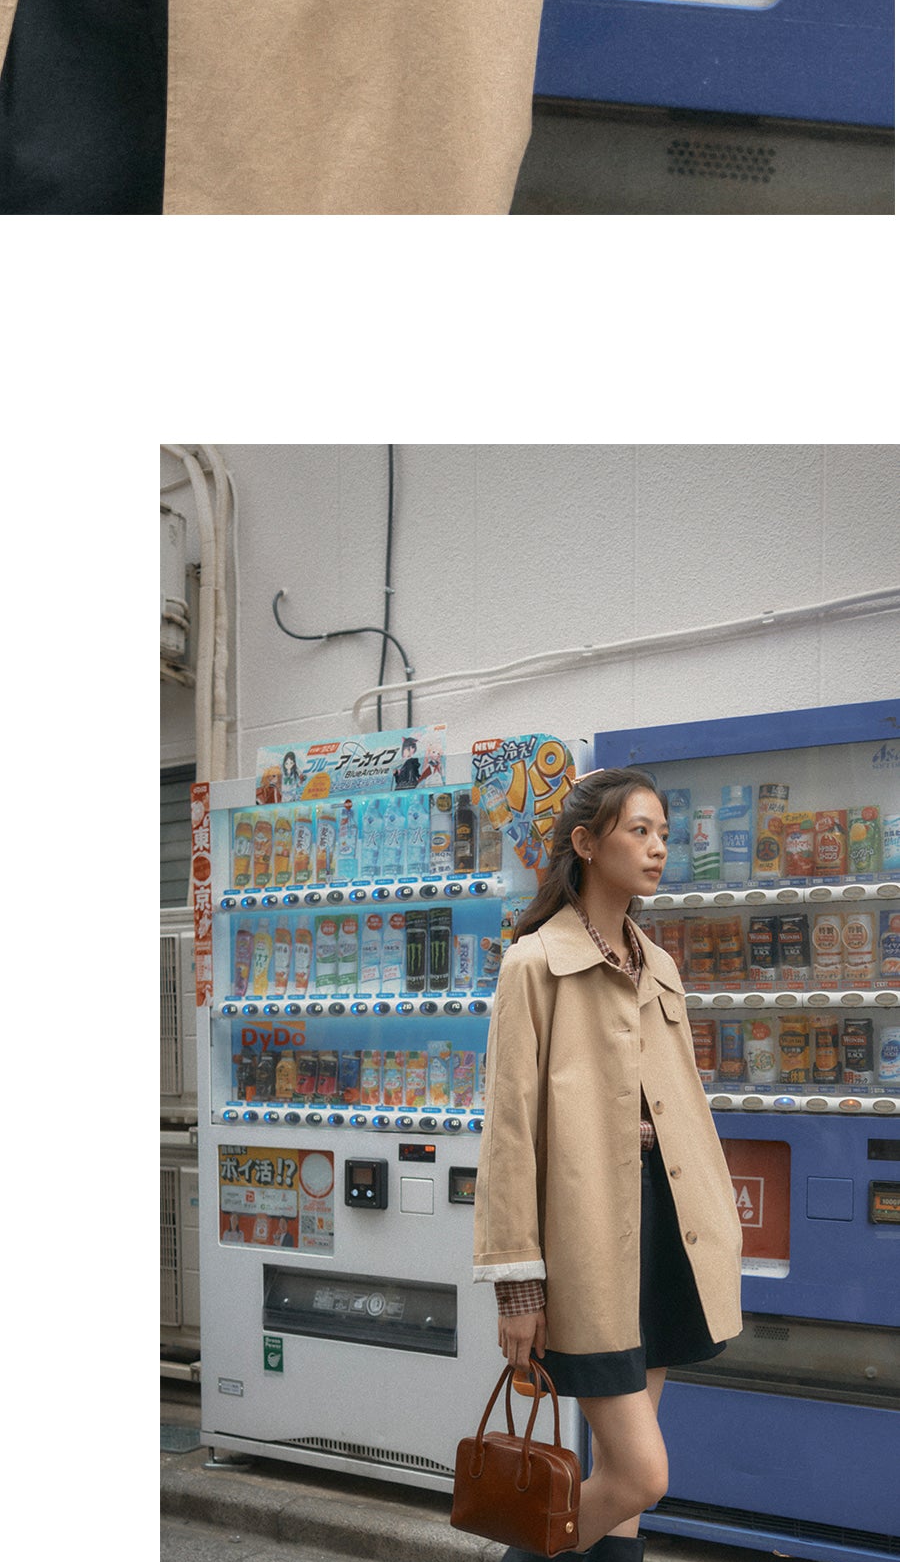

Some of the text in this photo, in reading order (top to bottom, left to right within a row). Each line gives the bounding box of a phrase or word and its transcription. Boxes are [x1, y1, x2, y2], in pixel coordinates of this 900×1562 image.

[475, 740, 497, 752] NEW
[303, 748, 400, 774] ブルーアーカイブ
[241, 1028, 306, 1052] DyDo
